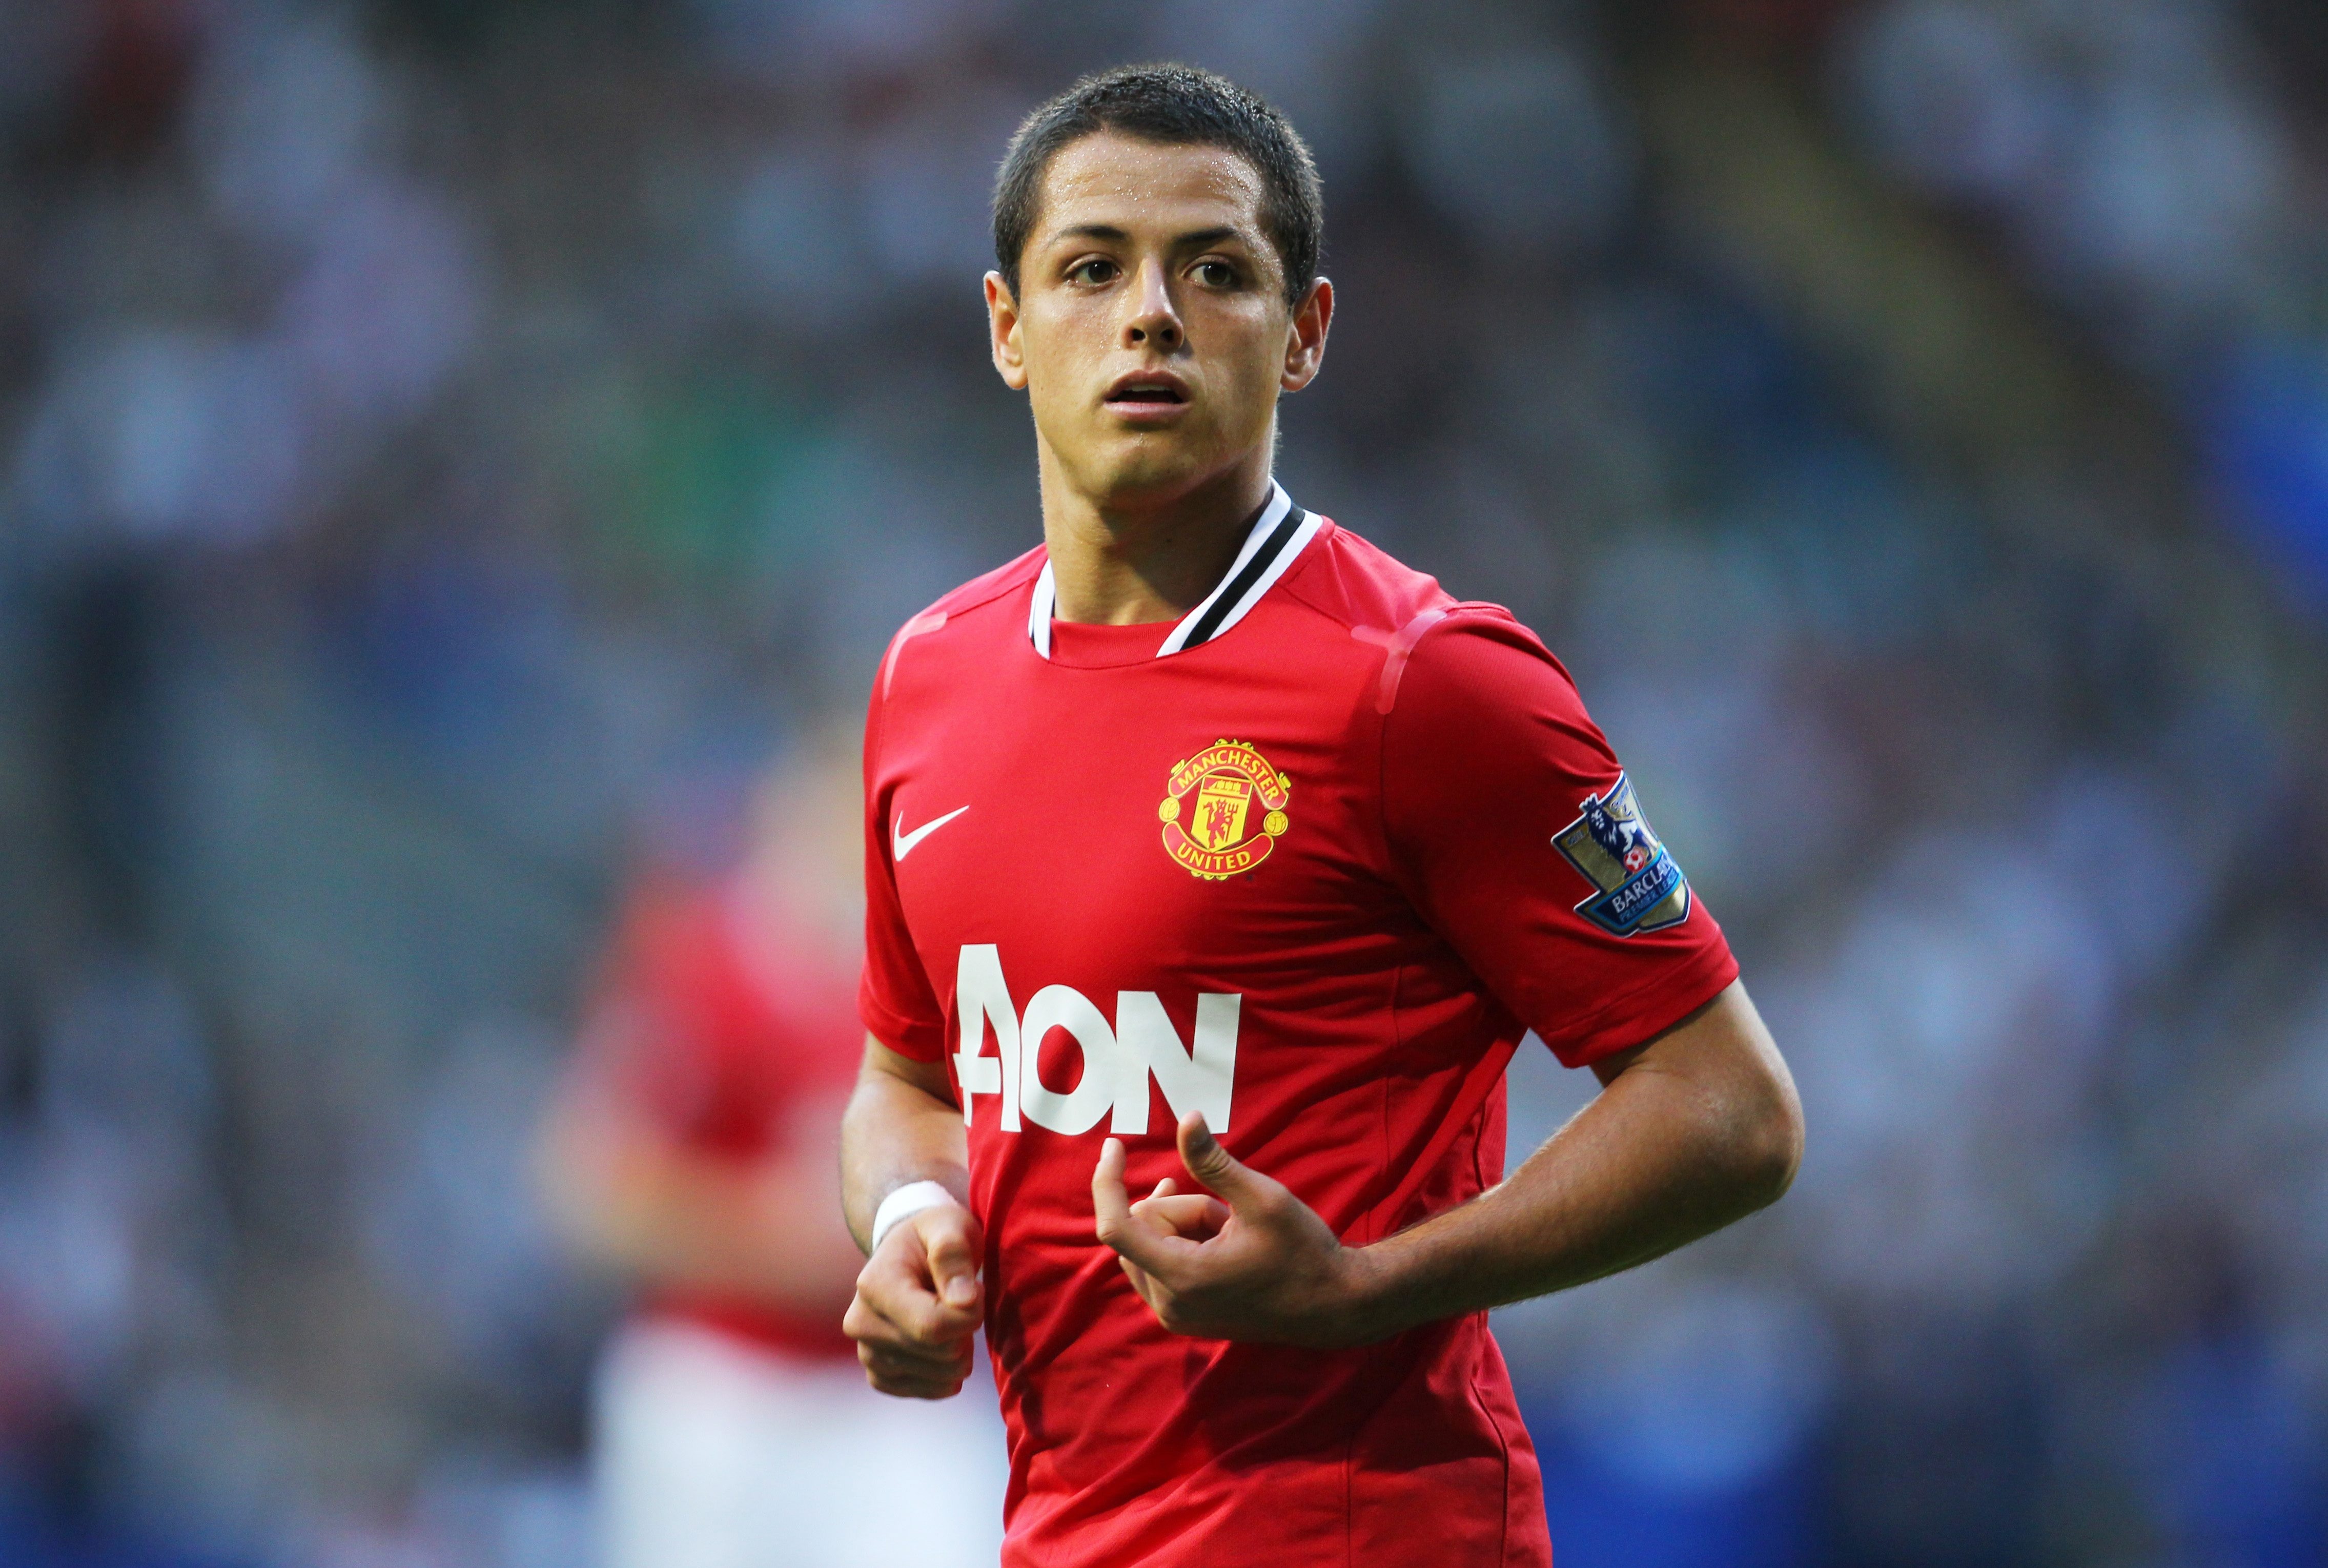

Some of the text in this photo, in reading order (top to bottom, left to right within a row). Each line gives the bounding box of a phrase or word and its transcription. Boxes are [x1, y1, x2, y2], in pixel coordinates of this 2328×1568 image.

[1177, 750, 1280, 802] MANCHESTER
[1177, 842, 1251, 870] UNITED
[1612, 854, 1671, 913] BARCLA
[953, 943, 1242, 1136] AON
